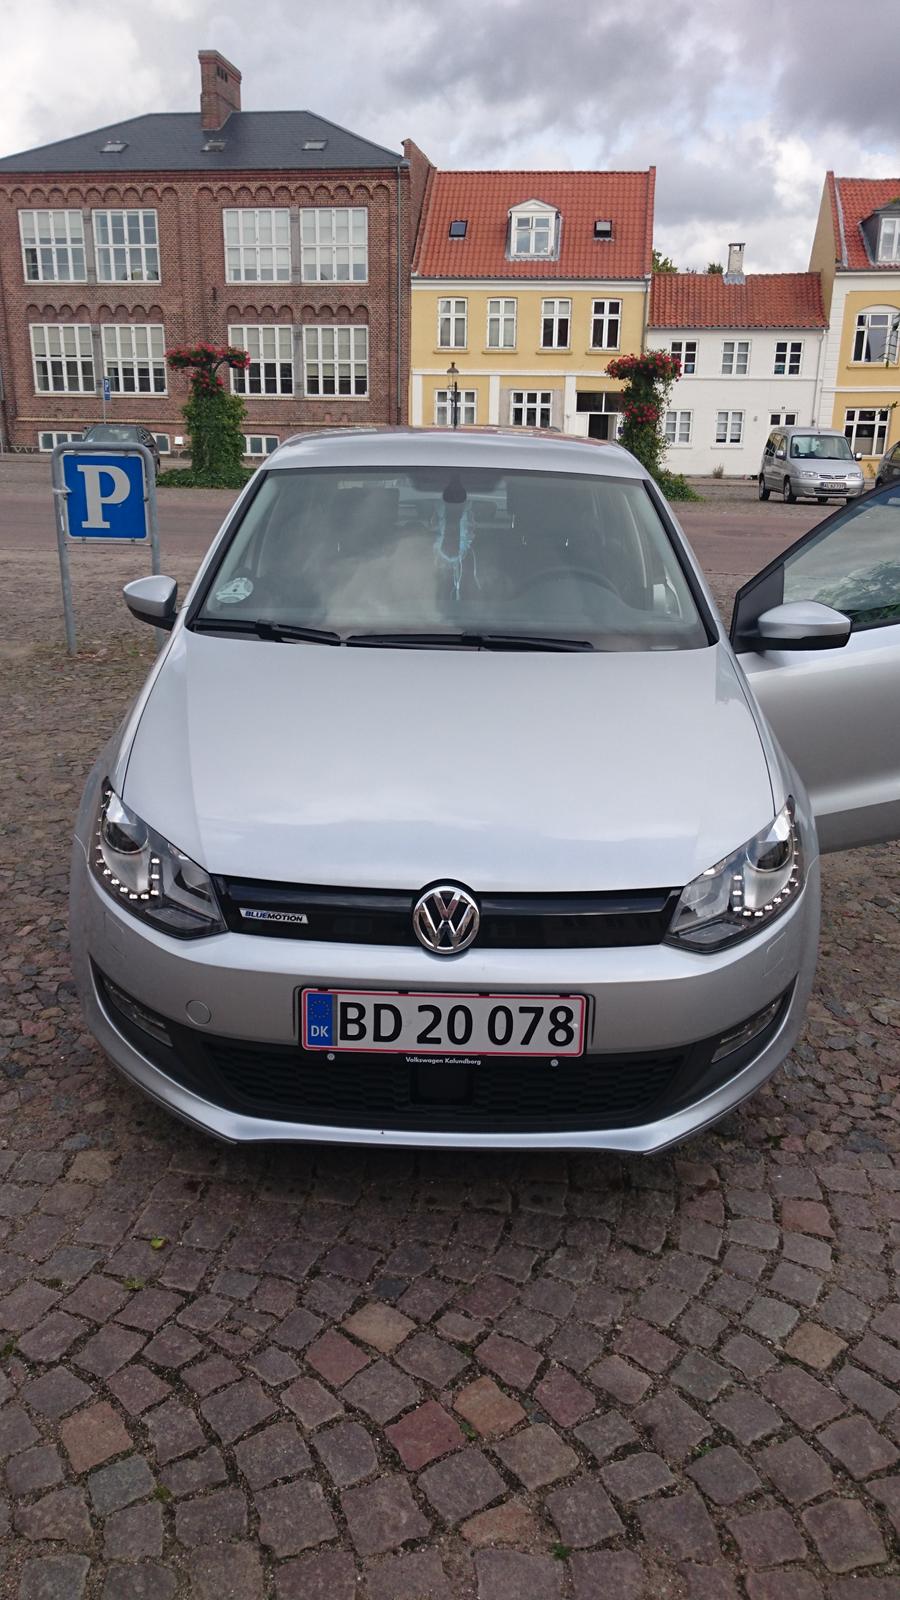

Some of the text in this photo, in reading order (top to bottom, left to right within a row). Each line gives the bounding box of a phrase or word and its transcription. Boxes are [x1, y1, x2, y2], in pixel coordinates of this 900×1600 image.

[77, 464, 131, 529] P
[244, 909, 304, 922] BLUEMOTION
[413, 885, 480, 954] VW
[310, 1025, 329, 1038] DK
[339, 1001, 575, 1047] BD 20 078
[405, 1056, 482, 1066] Volkswagen Kalundborg
